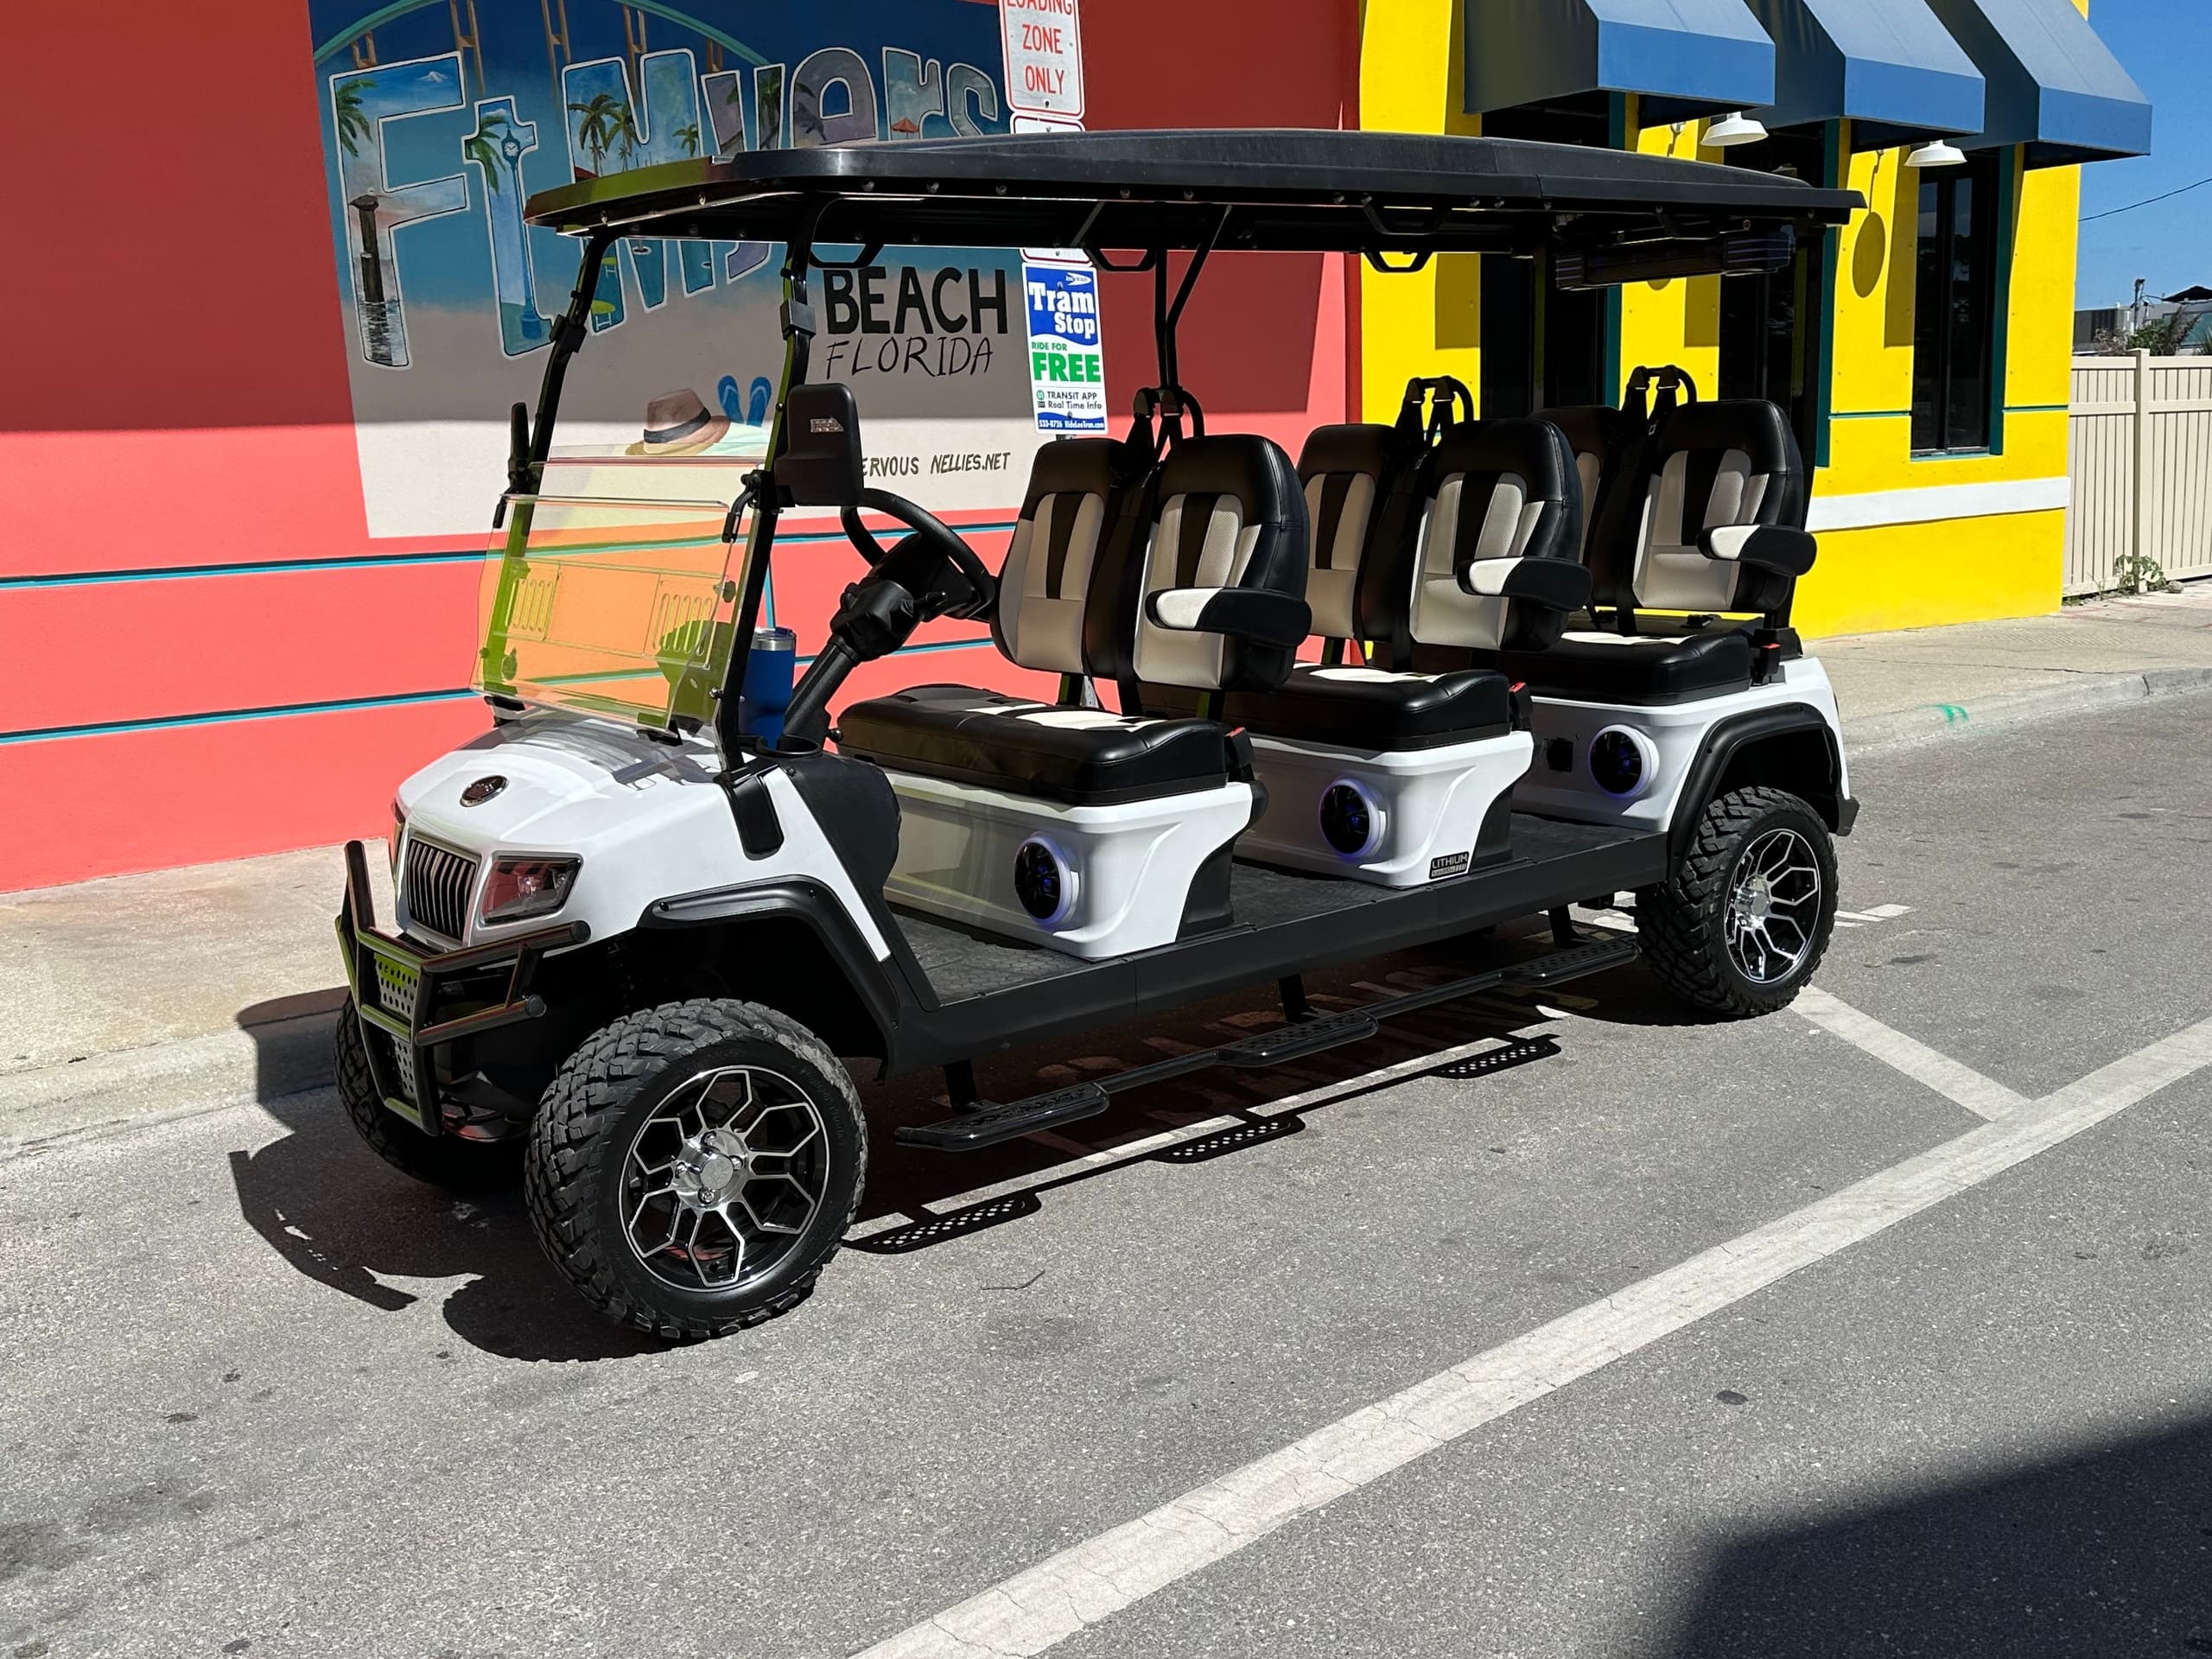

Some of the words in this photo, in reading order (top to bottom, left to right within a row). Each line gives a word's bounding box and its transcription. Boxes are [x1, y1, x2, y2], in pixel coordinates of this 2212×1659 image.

[1021, 23, 1064, 54] ZONE
[1025, 65, 1065, 95] ONLY
[329, 50, 555, 370] Ft
[823, 266, 1008, 334] BEACH
[1027, 282, 1095, 315] Tram
[1054, 312, 1096, 340] Stop
[826, 336, 994, 380] FLORIDA
[1031, 341, 1050, 351] RIDE
[1052, 342, 1068, 352] FOR
[1032, 353, 1102, 382] FREE
[1046, 391, 1079, 400] TRANSIT
[1087, 401, 1102, 410] Info
[862, 455, 919, 477] ERVOUS
[930, 452, 1011, 474] NELLIES.NET
[1433, 854, 1467, 868] LITHIUM
